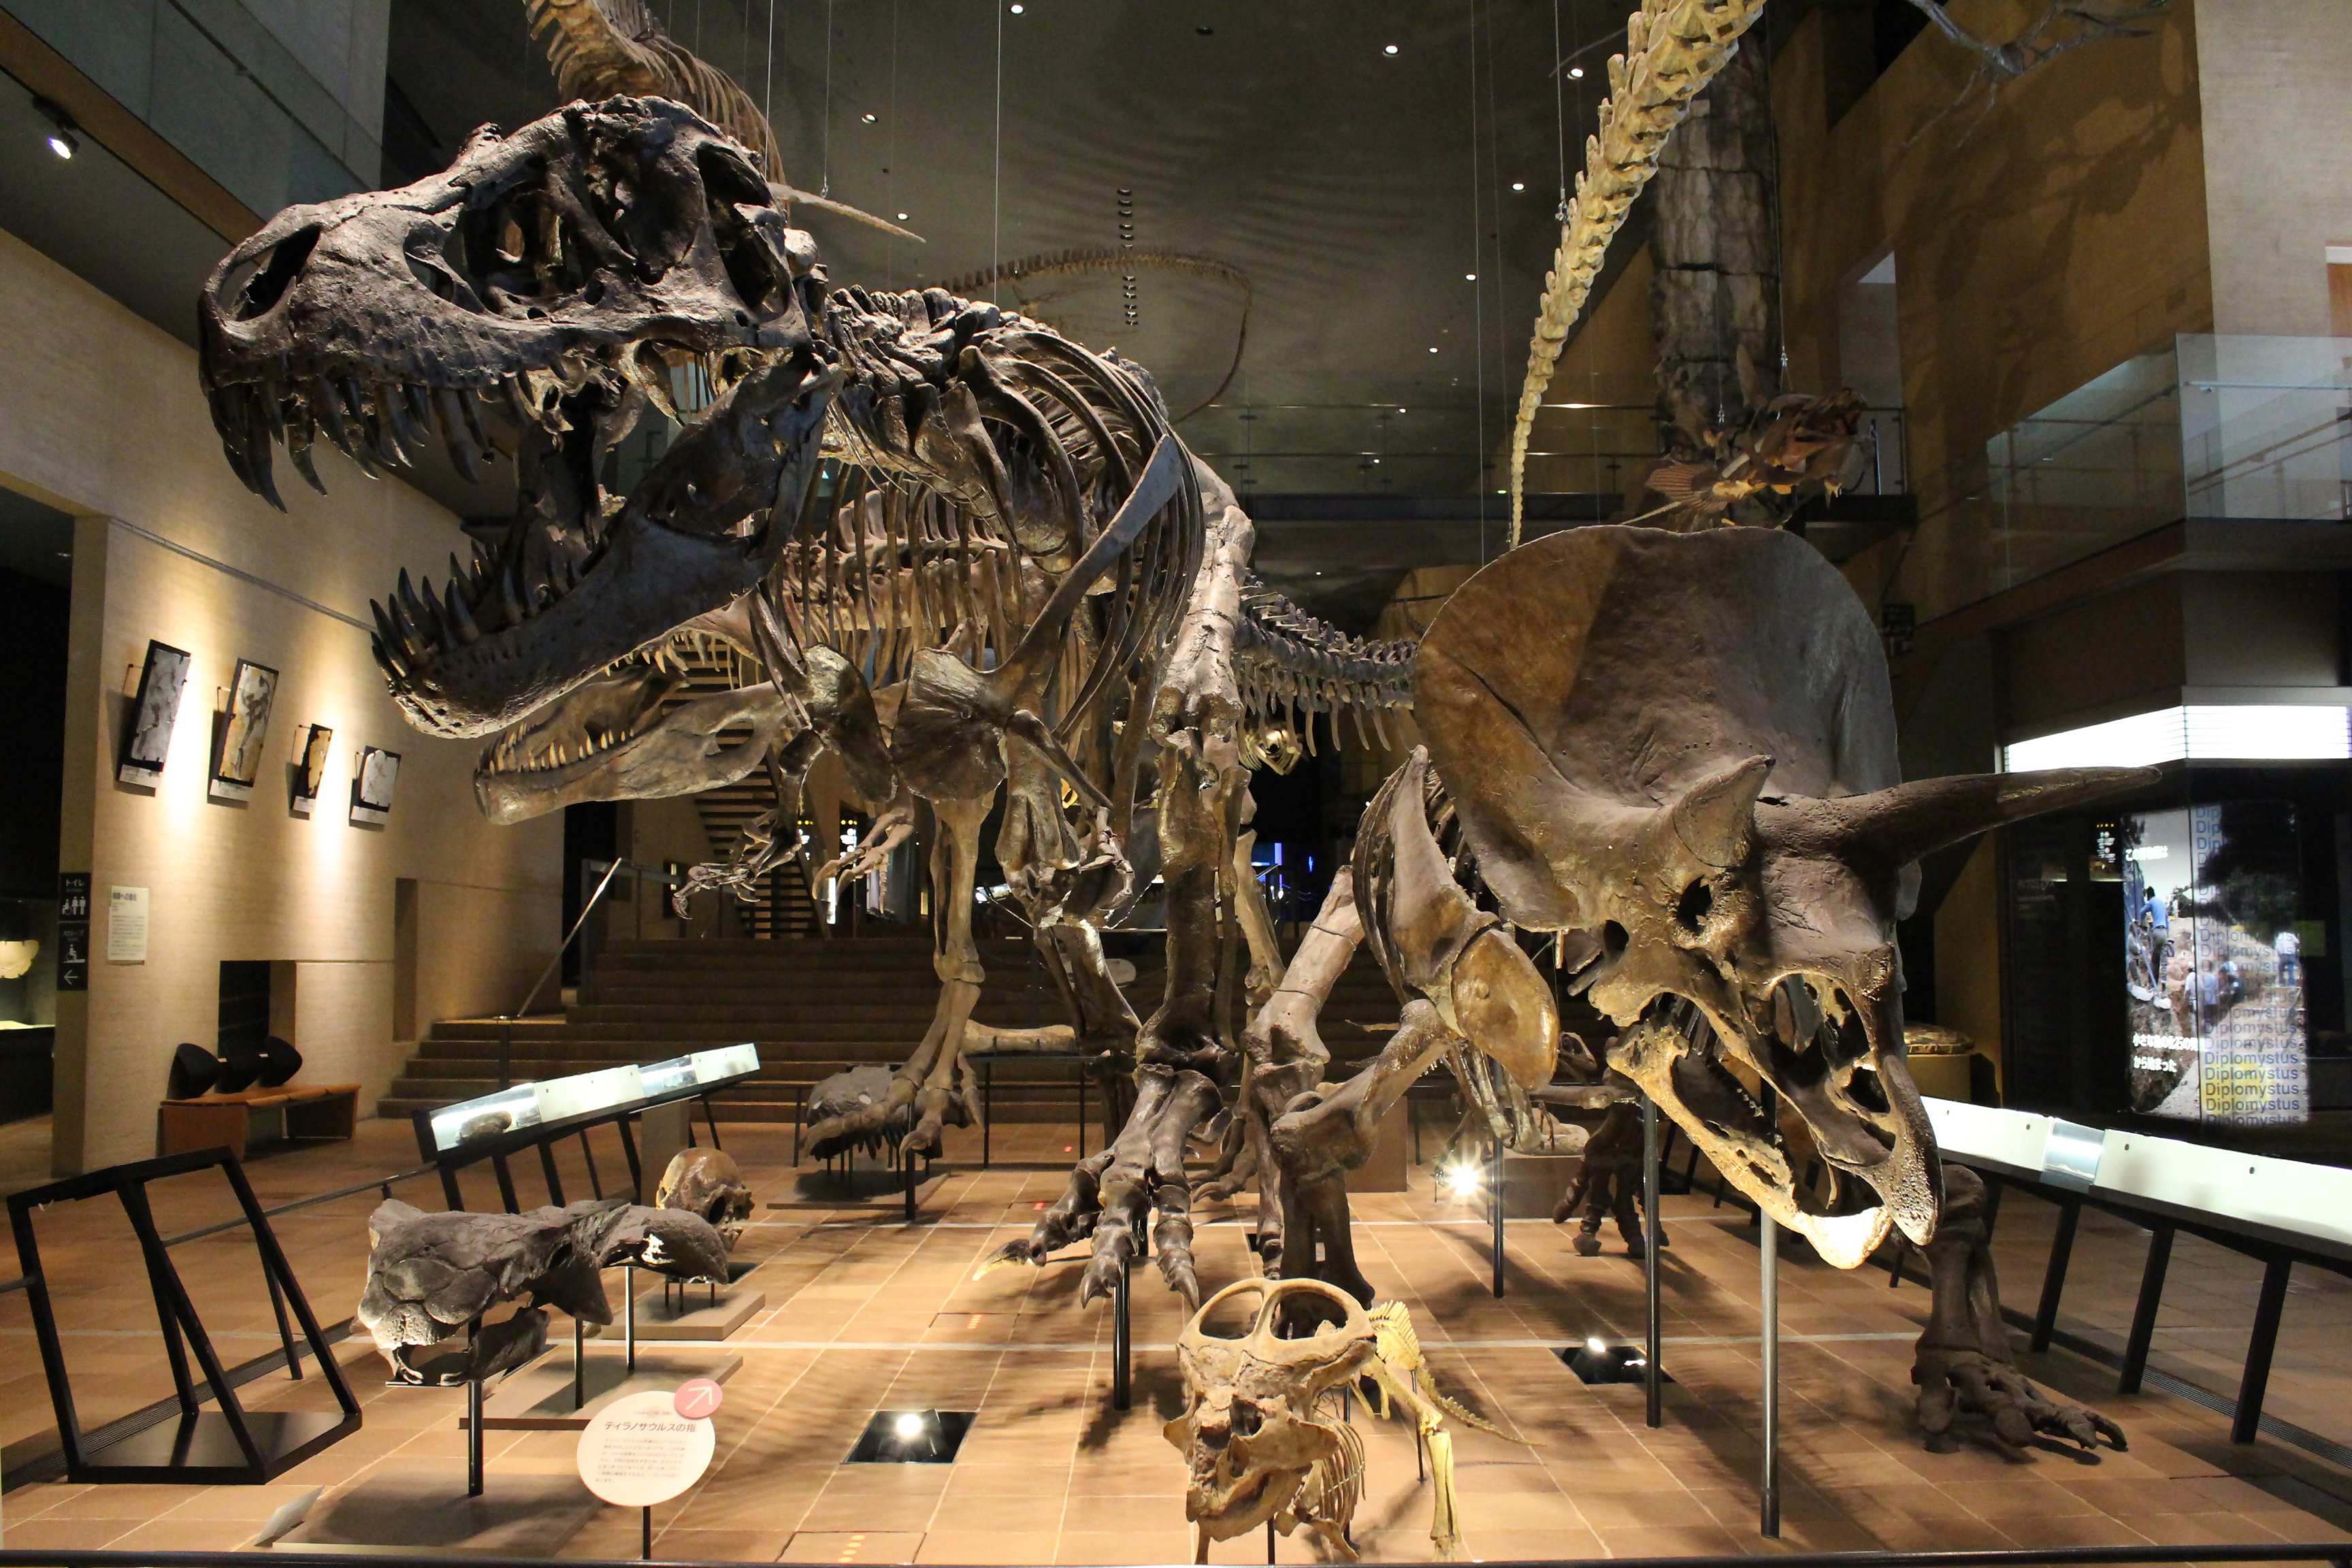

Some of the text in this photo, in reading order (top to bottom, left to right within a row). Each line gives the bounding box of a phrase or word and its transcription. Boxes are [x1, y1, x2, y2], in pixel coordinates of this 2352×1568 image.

[66, 879, 84, 887] トイレ
[2200, 929, 2294, 945] Diplomyus
[2204, 1022, 2297, 1036] Diplomystus
[2204, 1036, 2298, 1052] Diplomystus
[2204, 1051, 2298, 1068] Diplomystus
[2205, 1067, 2299, 1083] Diplomystus
[2206, 1082, 2300, 1098] Diplomystus
[2206, 1098, 2300, 1114] Diplomystus
[604, 1421, 696, 1433] ティラノサウルスの指
